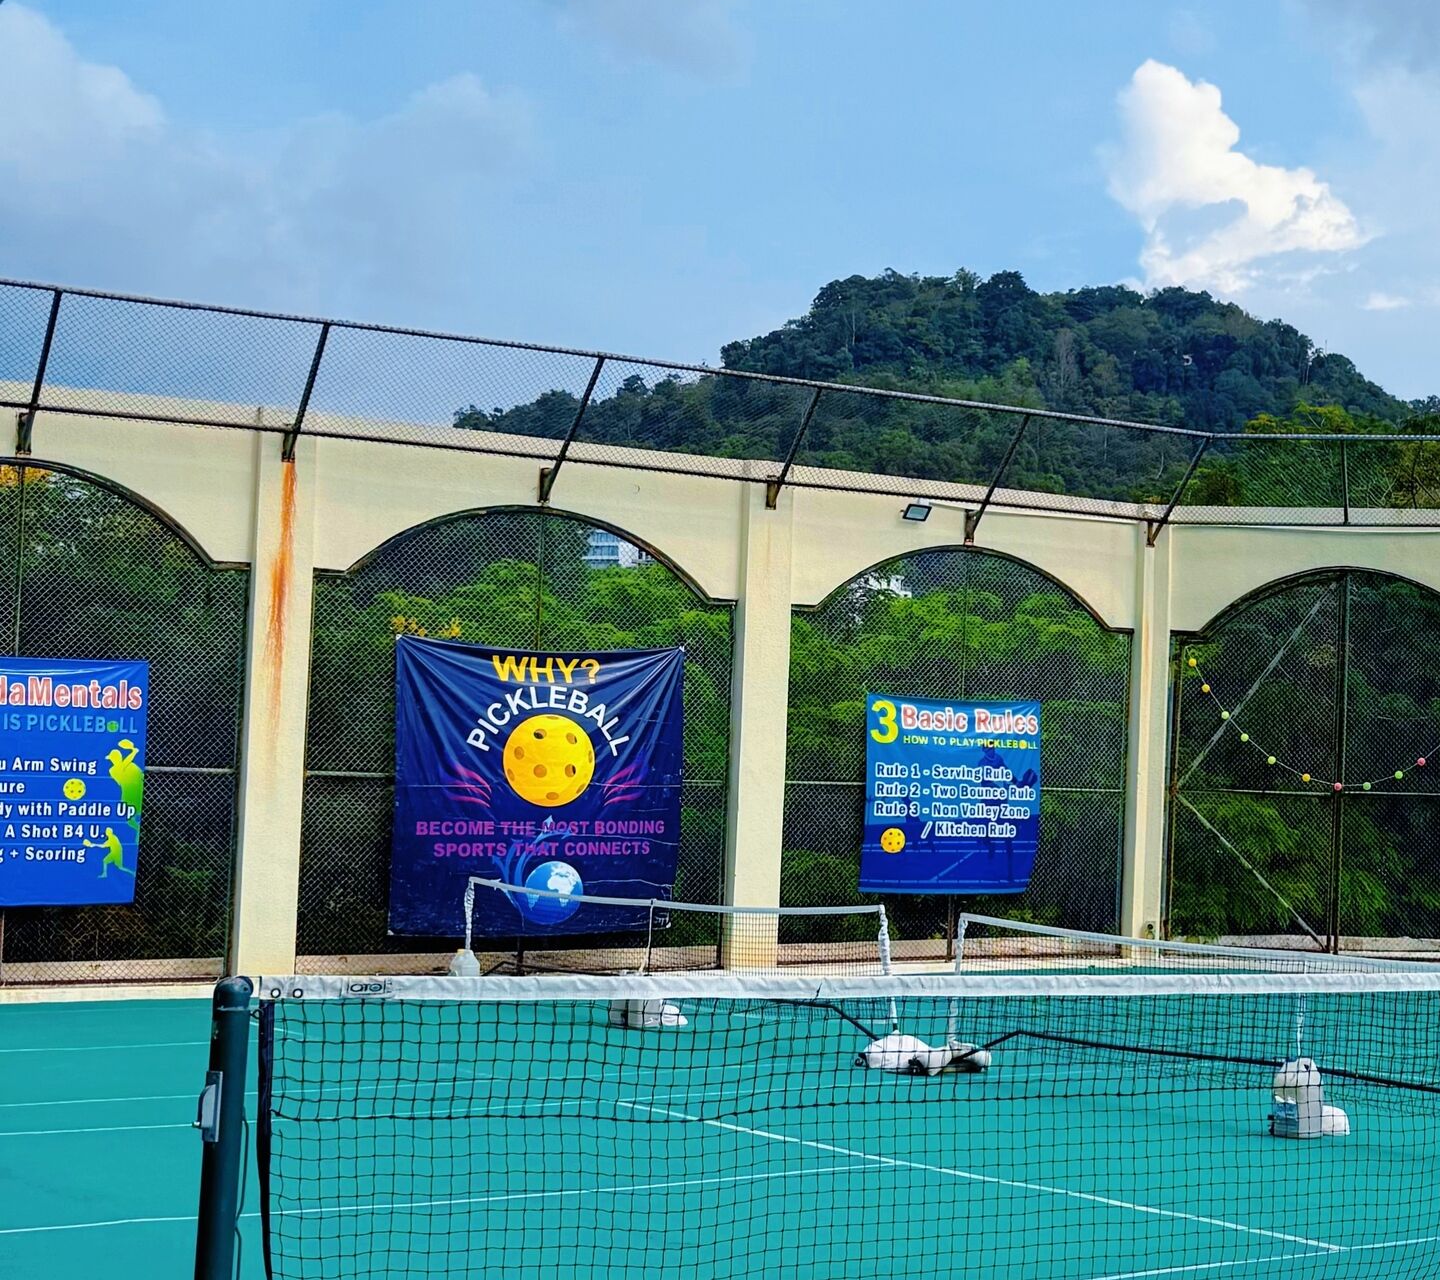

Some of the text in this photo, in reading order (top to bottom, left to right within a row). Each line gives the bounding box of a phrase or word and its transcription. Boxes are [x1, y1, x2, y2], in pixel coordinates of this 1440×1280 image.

[492, 655, 600, 684] WHY?
[3, 713, 138, 734] IS PICKLEBLL
[466, 686, 630, 756] PICKLEBALL
[870, 700, 899, 744] 3
[901, 704, 1038, 735] Basic Rules
[903, 735, 928, 745] HOW
[933, 736, 946, 746] TO
[950, 738, 974, 747] PLAY
[12, 757, 44, 771] Arm
[50, 757, 97, 775] Swing
[876, 762, 908, 777] Rule
[911, 763, 920, 778] 1
[932, 765, 982, 783] Serving
[984, 766, 1012, 781] Rule
[875, 782, 907, 797] Rule
[910, 783, 920, 797] 2
[932, 784, 957, 798] Two
[960, 785, 1007, 799] Bounce
[1009, 786, 1035, 801] Rule
[18, 802, 52, 816] with
[58, 802, 111, 817] Paddle
[117, 804, 136, 819] Up
[874, 801, 907, 816] Rule
[909, 802, 919, 816] 3
[932, 803, 958, 817] Non
[960, 803, 1000, 820] Volley
[1000, 805, 1030, 819] Zone
[5, 824, 15, 838] A
[21, 824, 58, 838] Shot
[63, 825, 84, 838] B4
[416, 821, 495, 836] BECOME
[500, 821, 537, 836] THE
[594, 820, 665, 835] BONDING
[935, 822, 986, 837] Kitchen
[988, 823, 1016, 837] Rule
[25, 846, 86, 863] Scoring
[433, 841, 651, 857] SPORTS THAT CONNECTS
